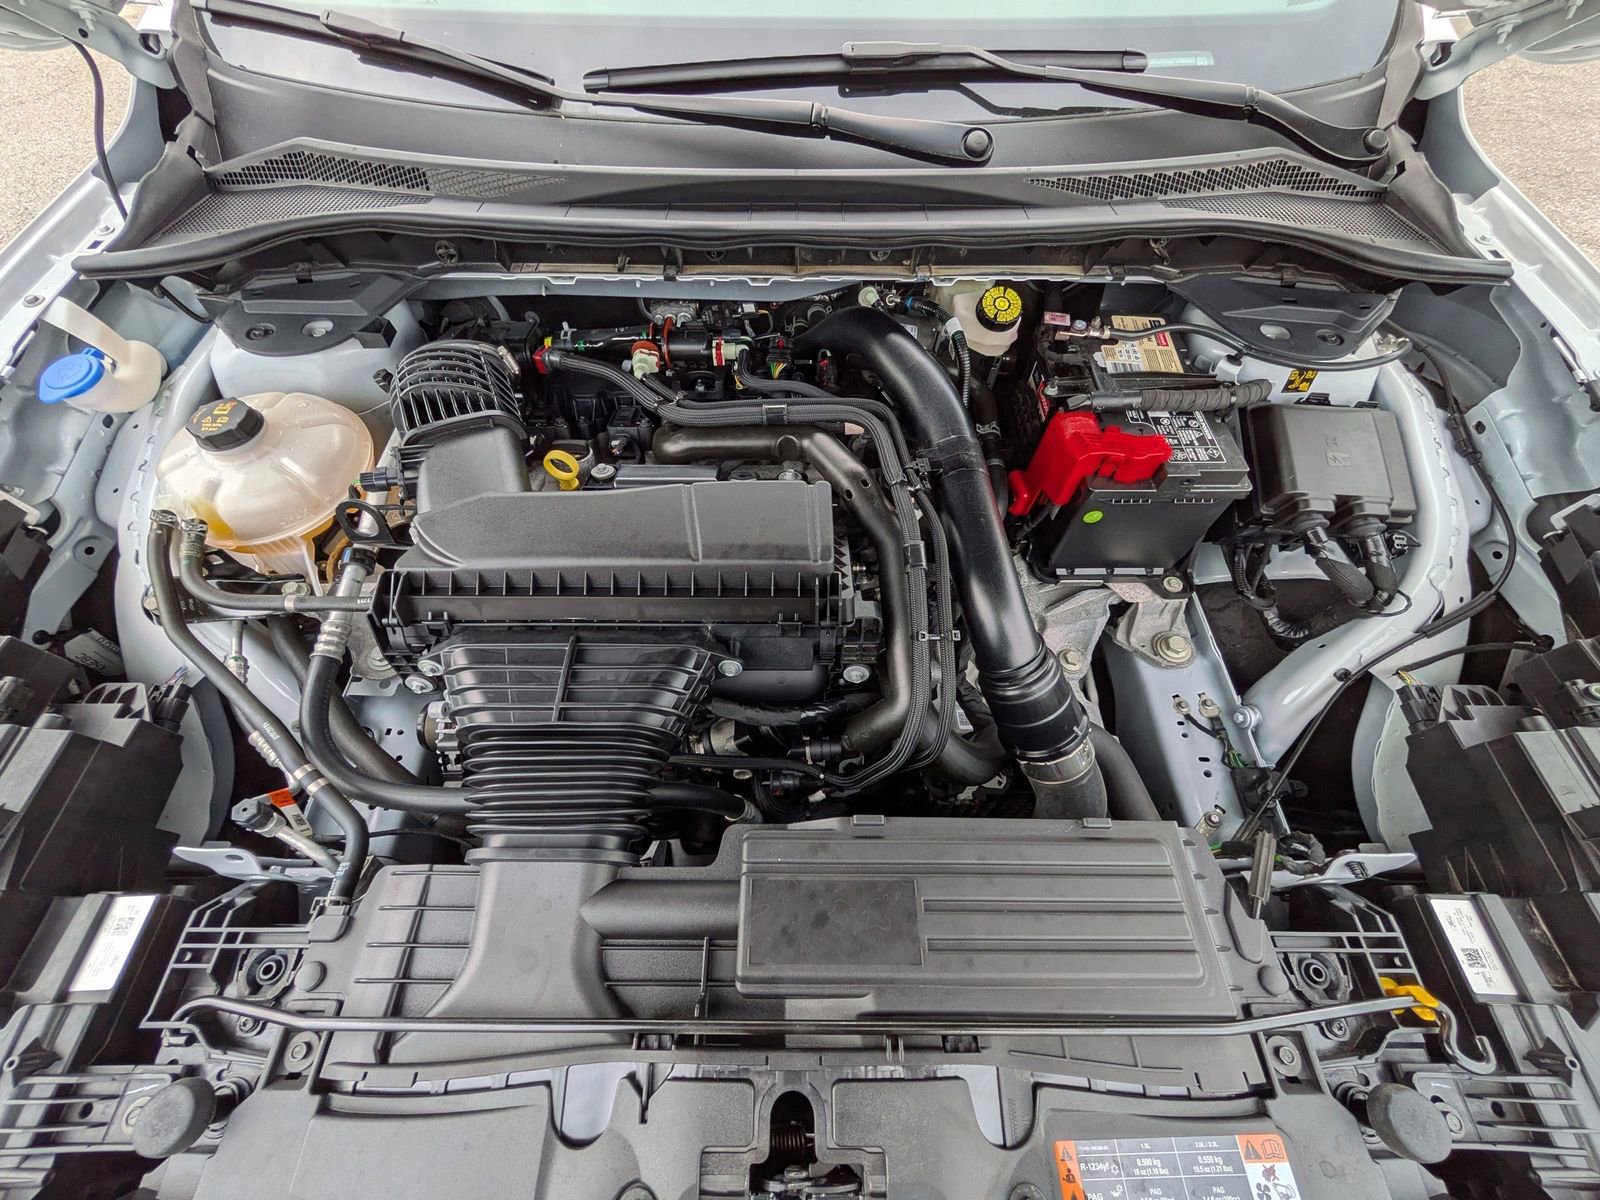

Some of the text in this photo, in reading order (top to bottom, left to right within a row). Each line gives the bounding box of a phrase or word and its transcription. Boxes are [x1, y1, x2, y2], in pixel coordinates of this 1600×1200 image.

[1136, 1158, 1162, 1168] 0.500 kg
[1197, 1155, 1223, 1165] 0.550 kg
[1080, 1162, 1110, 1173] R-1234yf
[1149, 1188, 1162, 1196] PAG
[1212, 1186, 1225, 1194] PAG
